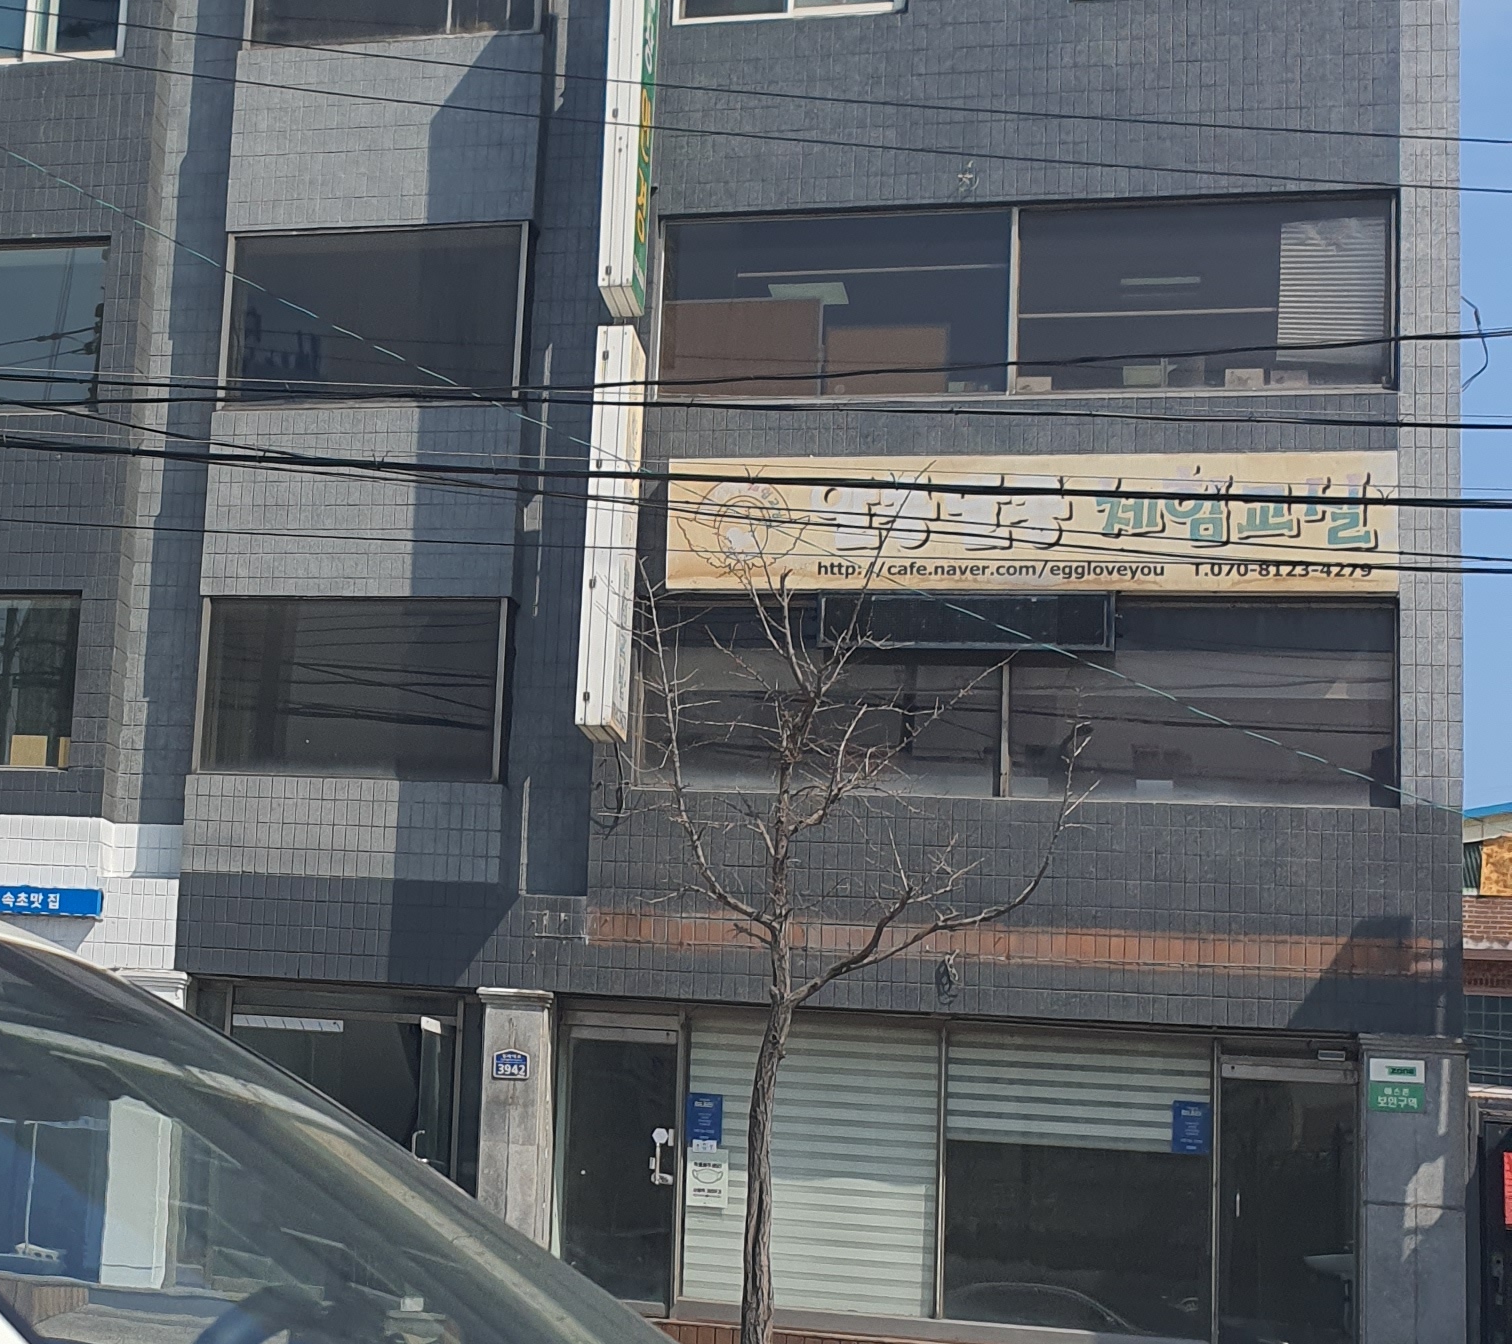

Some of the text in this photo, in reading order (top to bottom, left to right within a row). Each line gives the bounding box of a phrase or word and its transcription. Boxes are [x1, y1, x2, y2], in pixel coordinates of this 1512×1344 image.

[817, 560, 1373, 581] http://cafe.naver.com/eggloveyou T.070-8123-4279
[1, 891, 44, 909] 속초맛
[497, 1063, 526, 1076] 3942
